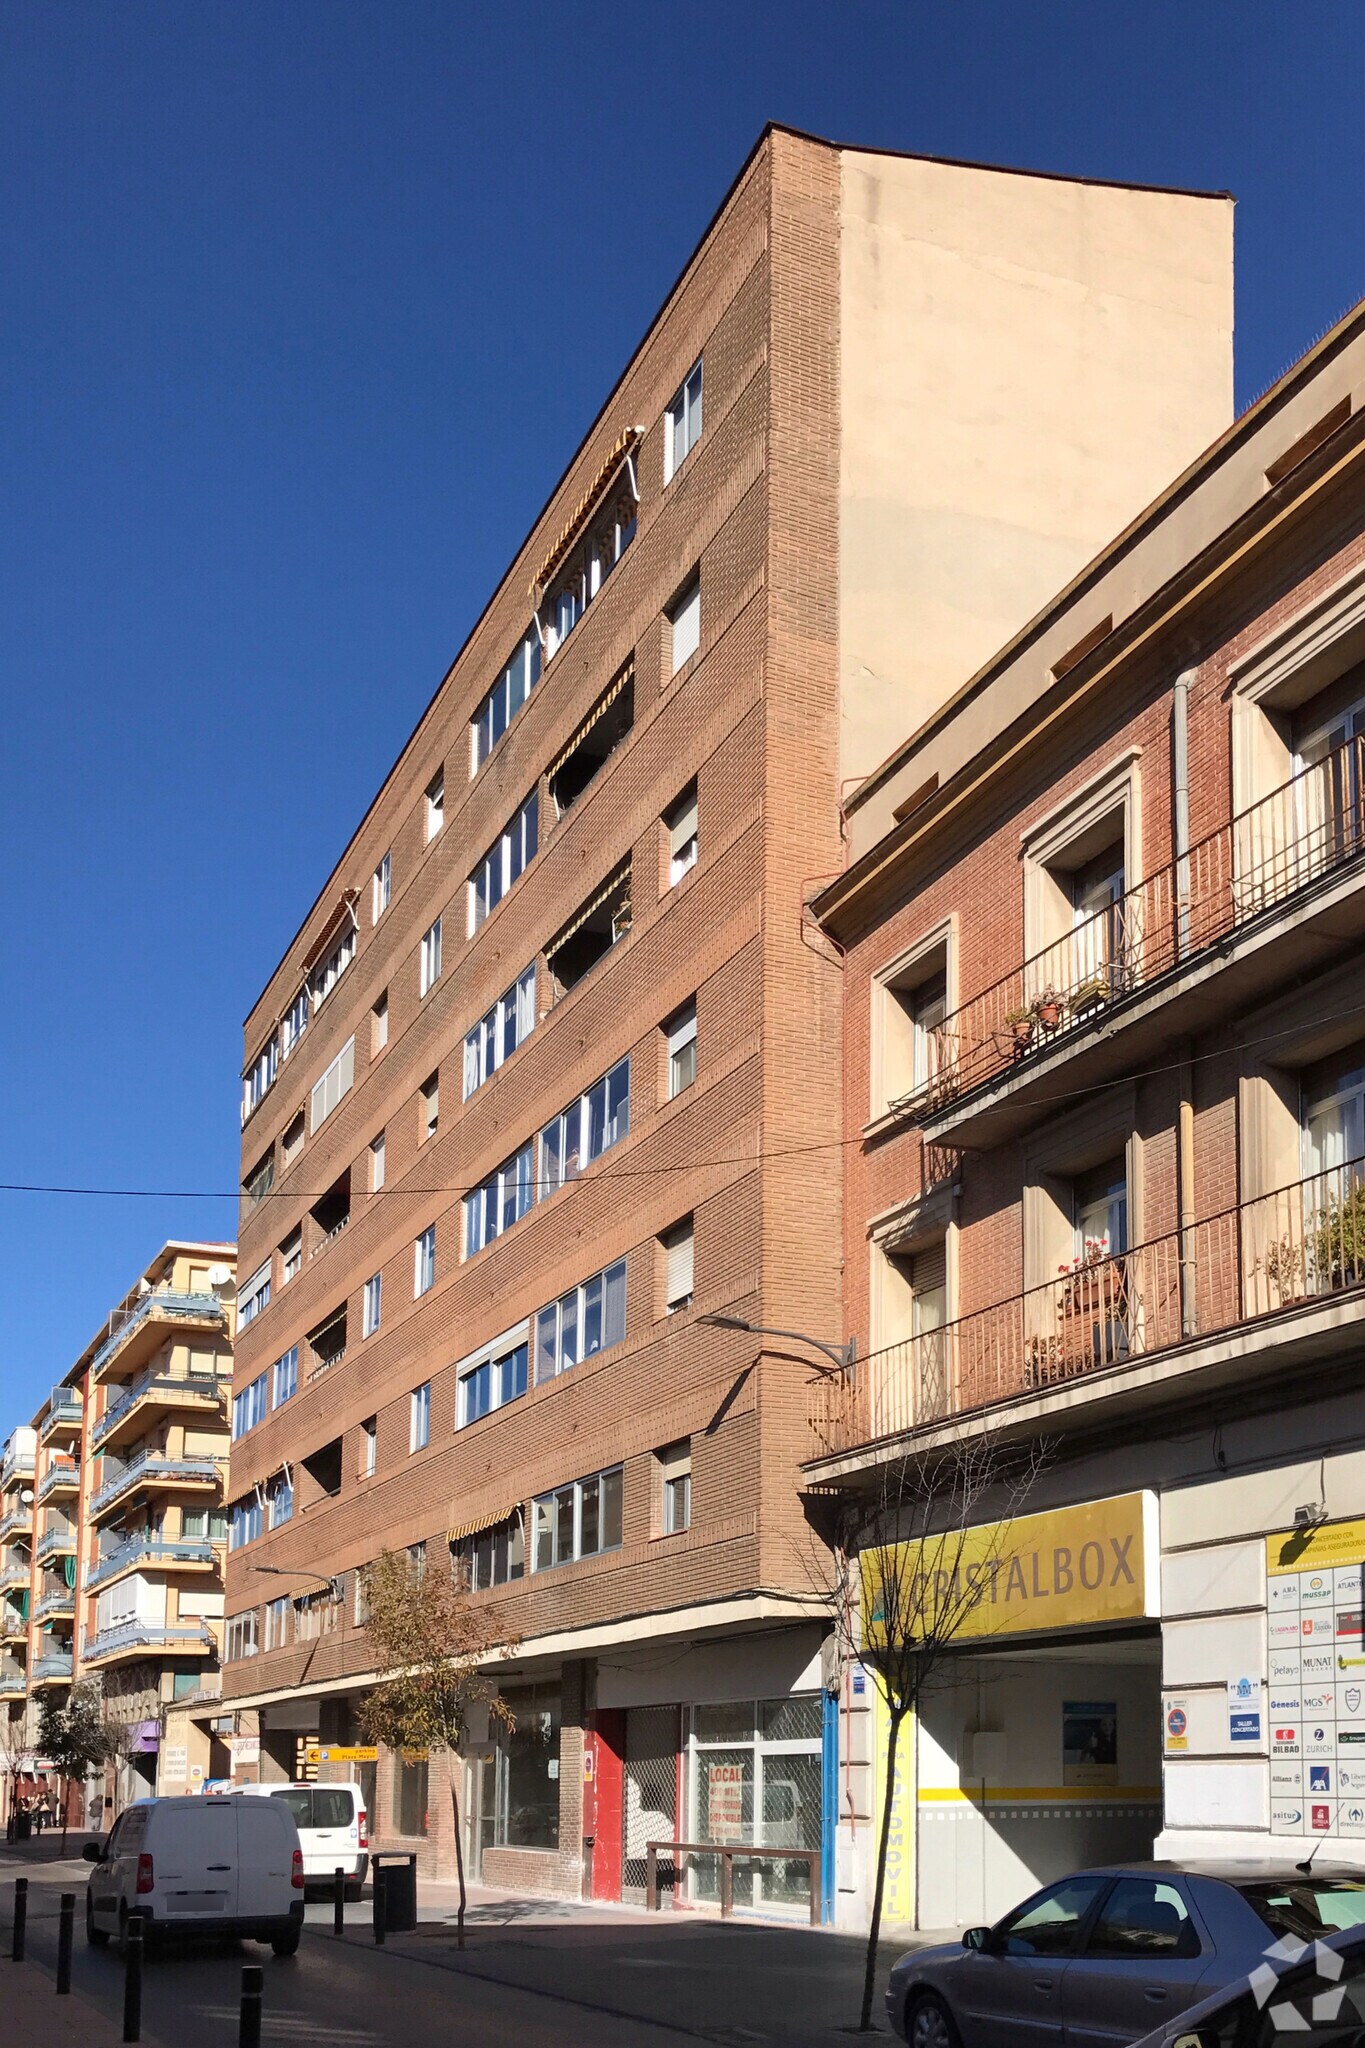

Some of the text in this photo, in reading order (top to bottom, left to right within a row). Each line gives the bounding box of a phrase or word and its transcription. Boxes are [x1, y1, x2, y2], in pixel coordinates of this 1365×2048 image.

[911, 1534, 1135, 1615] CRISTALBOX
[1302, 1590, 1331, 1599] mussap
[1302, 1656, 1332, 1668] MUNAT
[1274, 1665, 1299, 1677] pelayo
[1270, 1699, 1300, 1709] Genesis
[1304, 1698, 1323, 1707] MGS
[1231, 1725, 1259, 1733] CONCERTADO
[1272, 1745, 1300, 1754] BILBAO
[1306, 1744, 1333, 1753] ZURICH
[882, 1752, 905, 1760] PRA
[709, 1767, 740, 1783] LOCAL
[1311, 1779, 1327, 1790] AXA
[1273, 1811, 1296, 1819] asitur
